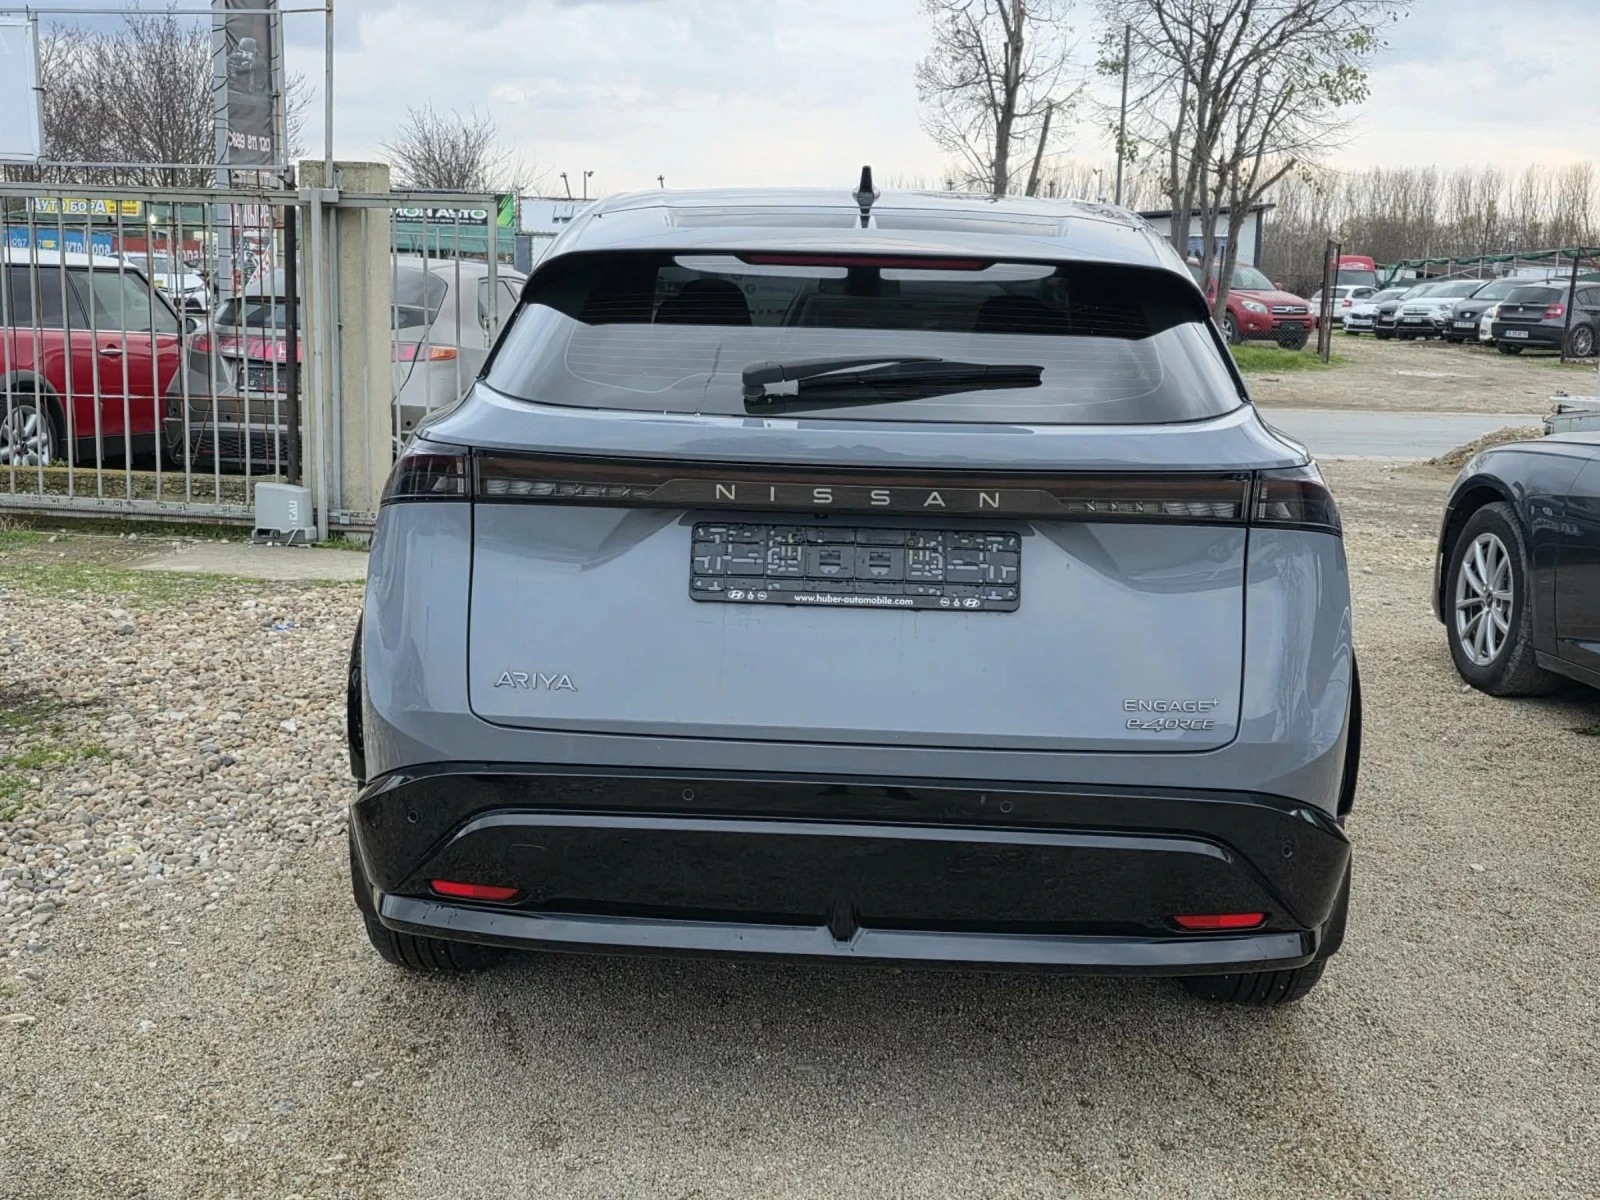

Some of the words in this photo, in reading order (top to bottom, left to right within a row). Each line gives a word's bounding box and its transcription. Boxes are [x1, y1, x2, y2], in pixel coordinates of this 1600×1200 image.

[715, 484, 1000, 508] NISSAN
[794, 593, 913, 606] www.huber-automobile.com
[494, 671, 577, 691] ARIYA
